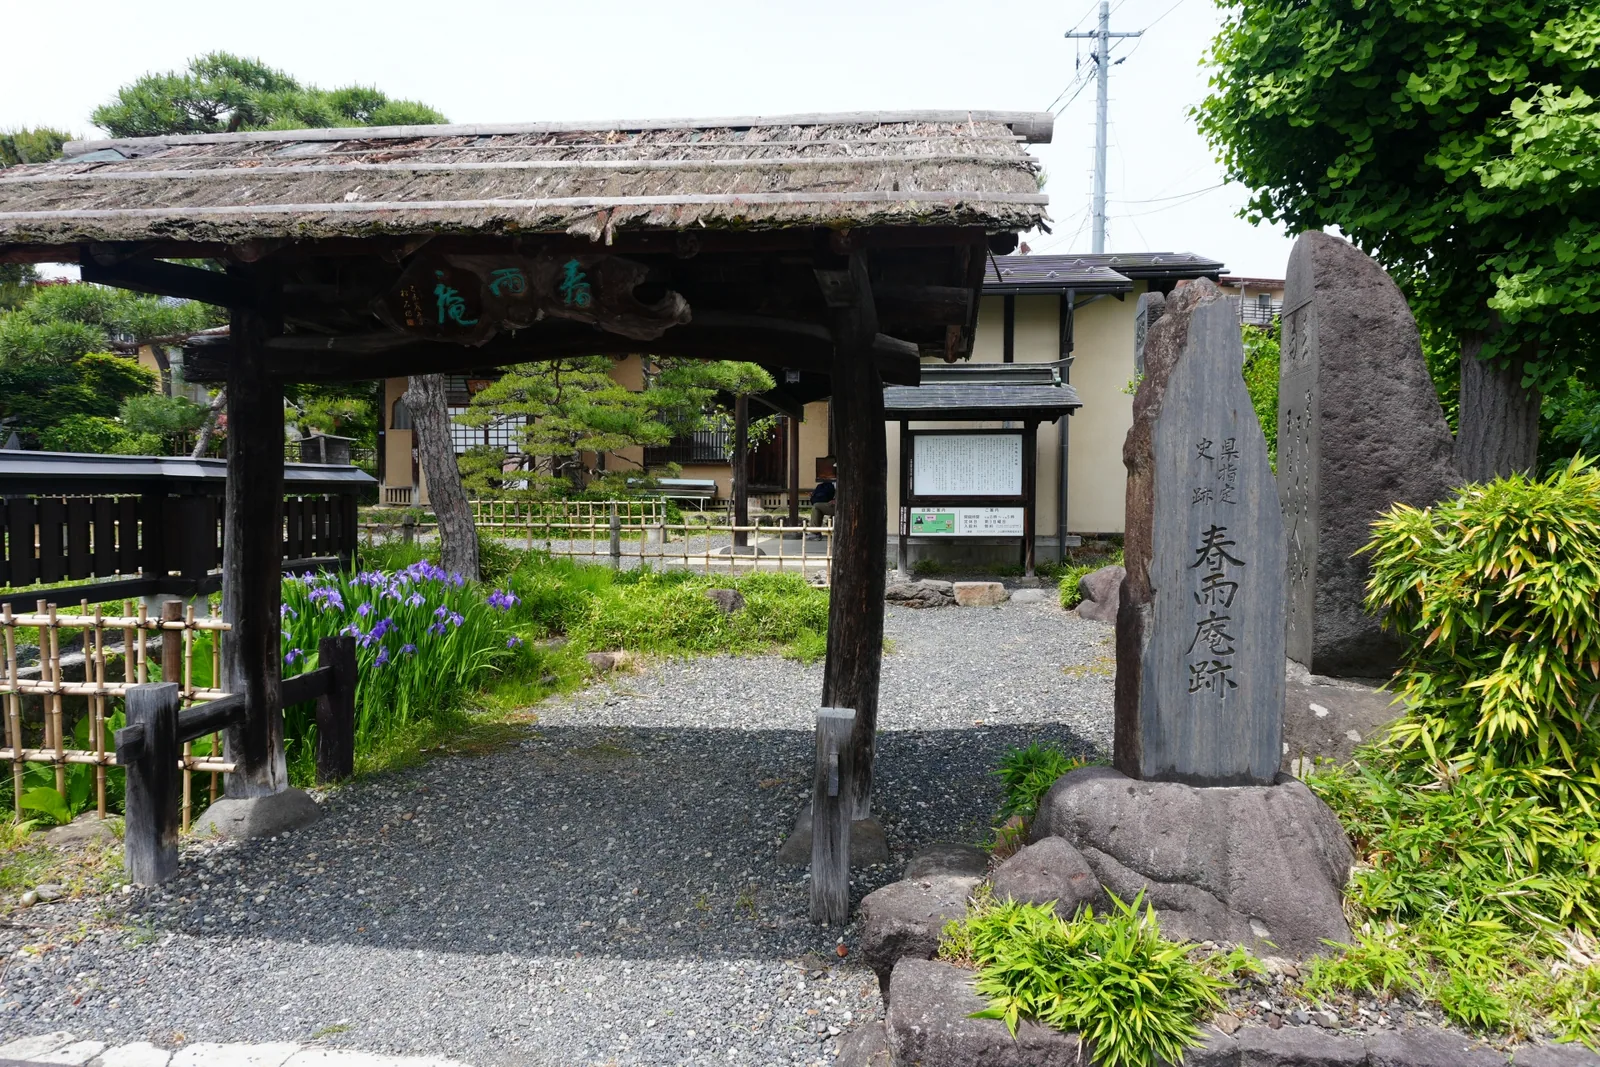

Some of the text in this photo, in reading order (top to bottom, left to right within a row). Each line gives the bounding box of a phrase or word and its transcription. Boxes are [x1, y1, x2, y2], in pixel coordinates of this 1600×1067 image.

[1191, 437, 1215, 506] 史跡
[1217, 438, 1240, 505] 県指定
[1185, 524, 1246, 699] 春雨庵跡
